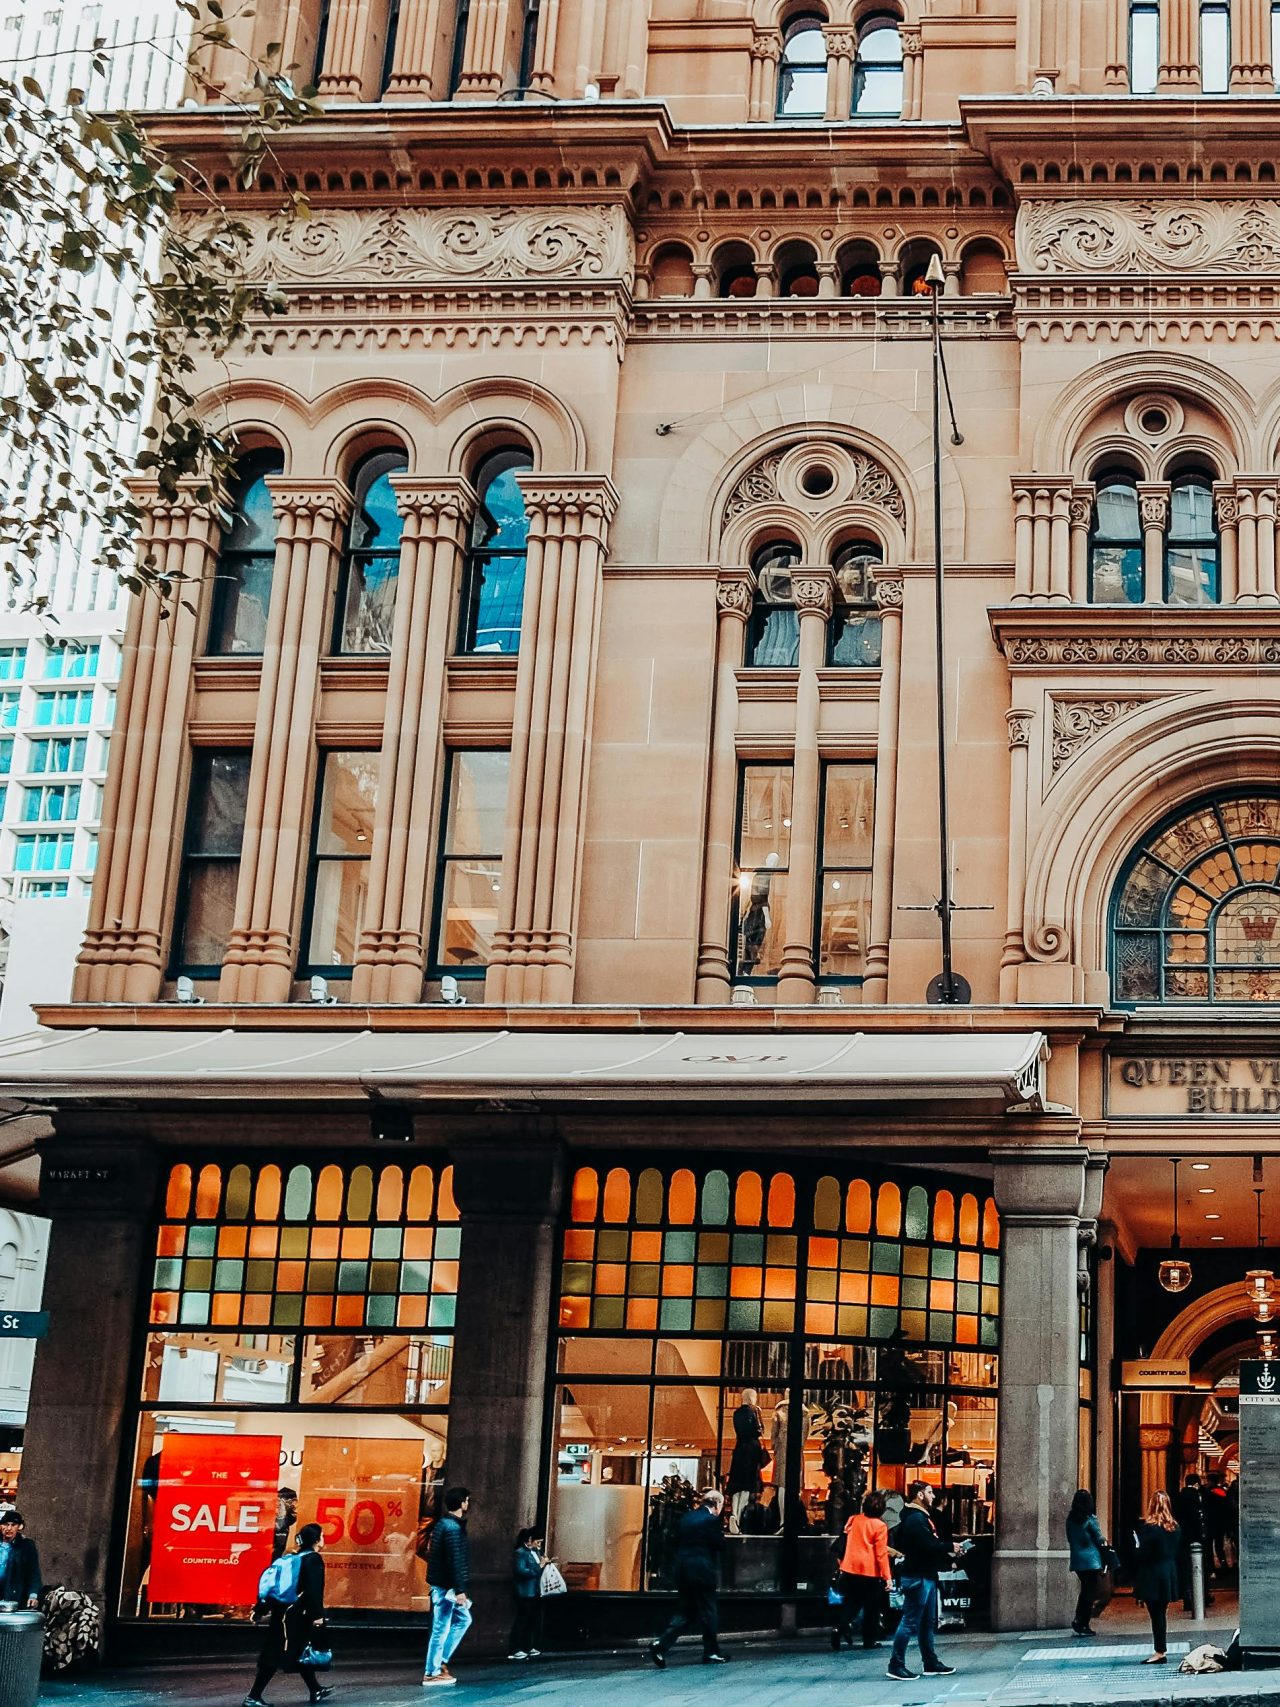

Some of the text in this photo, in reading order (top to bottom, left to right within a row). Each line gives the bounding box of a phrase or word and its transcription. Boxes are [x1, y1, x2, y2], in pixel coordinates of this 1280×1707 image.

[1120, 1059, 1232, 1087] QUEEN
[49, 1169, 89, 1179] MARKET
[2, 1314, 20, 1329] St
[211, 1471, 228, 1479] THE
[170, 1504, 261, 1533] SALE
[316, 1498, 403, 1545] 50%
[183, 1557, 217, 1565] COUNTRY
